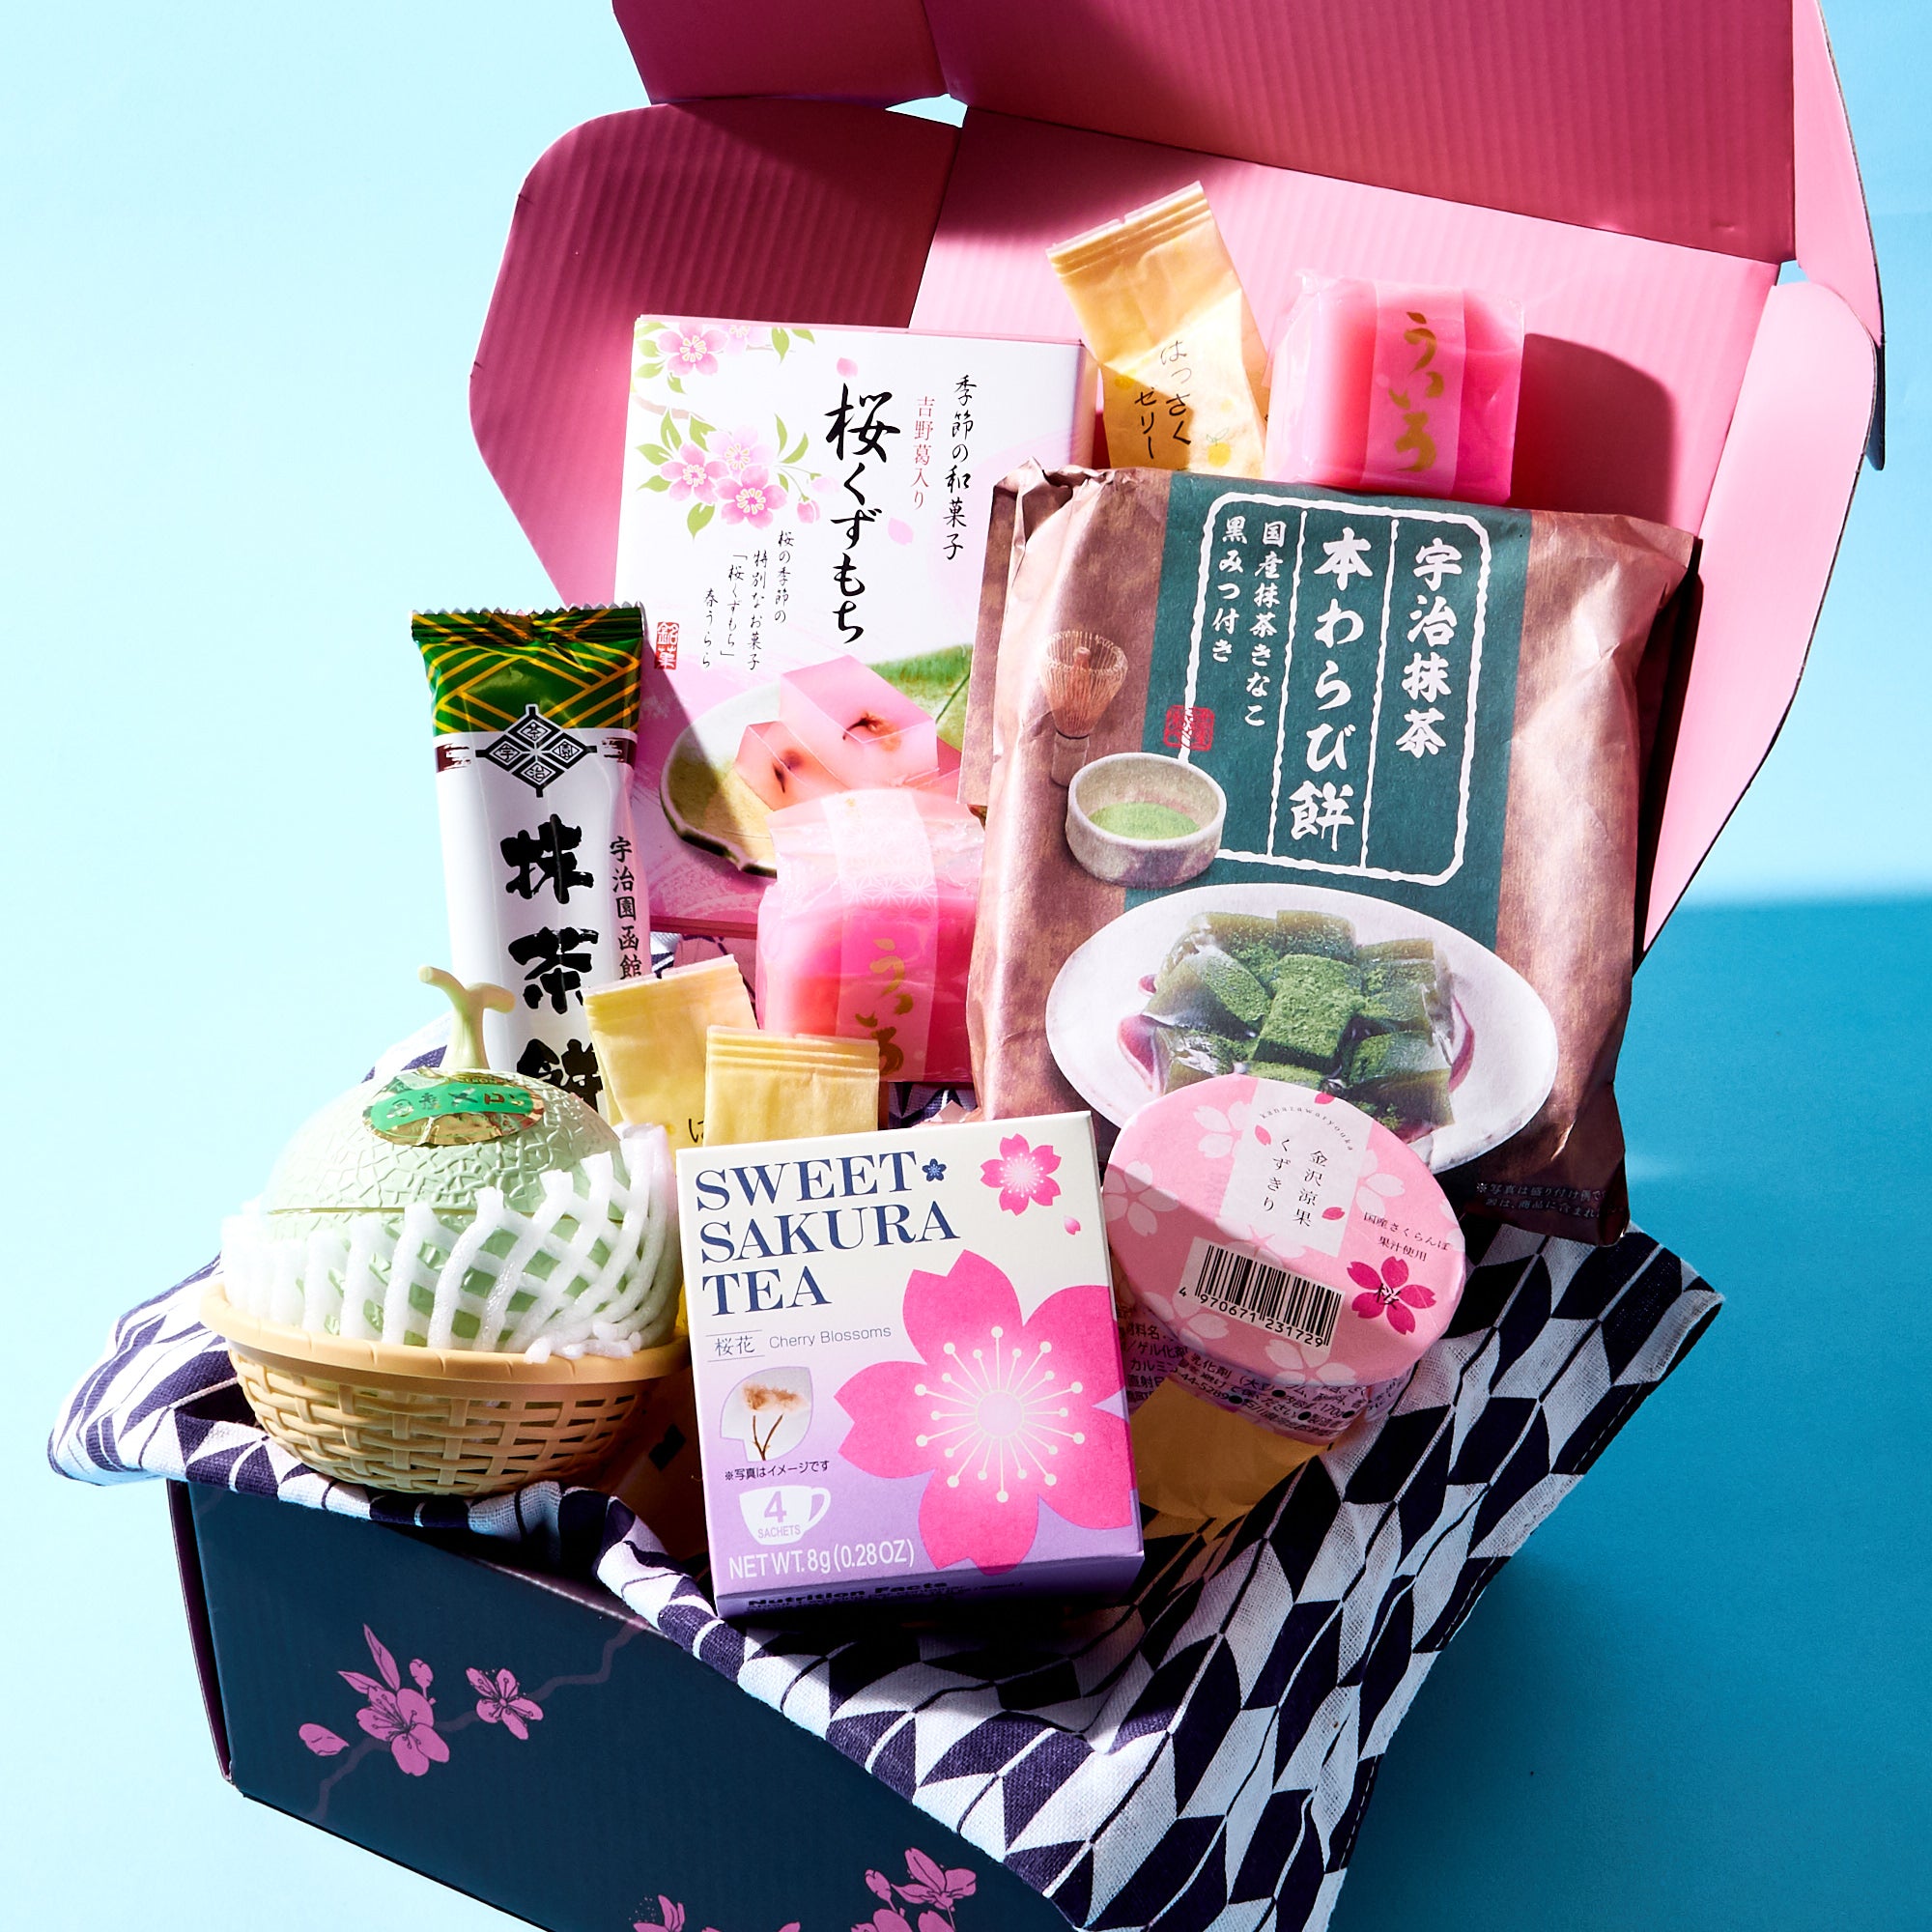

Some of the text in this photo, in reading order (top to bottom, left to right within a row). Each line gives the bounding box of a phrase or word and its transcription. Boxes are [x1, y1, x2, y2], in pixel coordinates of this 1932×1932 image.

[1134, 386, 1158, 460] ゼリー
[1160, 340, 1193, 445] はっさく
[910, 396, 935, 510] 吉野葛入り
[943, 374, 977, 560] 季節の和菓子
[824, 383, 901, 644] 桜くずもち
[748, 550, 768, 669] 特別なお菓子
[774, 529, 795, 623] 桜の季節の
[1211, 515, 1248, 664] 黒みつ付き
[702, 587, 718, 668] 春うらら
[1244, 521, 1287, 726] 国産抹茶きなこ
[1395, 537, 1463, 758] 宇治抹茶
[1289, 527, 1373, 851] 本わらび餅
[1260, 1106, 1353, 1151] kanazawaryouka
[695, 1151, 917, 1211] SWEET
[1264, 1139, 1291, 1211] くずきり
[1293, 1151, 1327, 1227] 金沢涼果
[700, 1200, 960, 1264] SAKURA
[1378, 1236, 1427, 1261] 果汁使用
[702, 1264, 832, 1316] TEA
[1179, 1287, 1324, 1347] 4 970671 231729
[1373, 1283, 1402, 1310] 桜
[715, 1335, 756, 1356] 桜花
[769, 1327, 892, 1349] Cherry Blossoms
[724, 1460, 830, 1481] ※写真はイメージです
[757, 1523, 801, 1539] SACHETS
[764, 1491, 787, 1523] 4
[729, 1553, 768, 1579] NET
[772, 1549, 805, 1575] WT.
[808, 1548, 831, 1574] 8g
[748, 1589, 866, 1607] Nutrition
[874, 1580, 948, 1594] Facts
